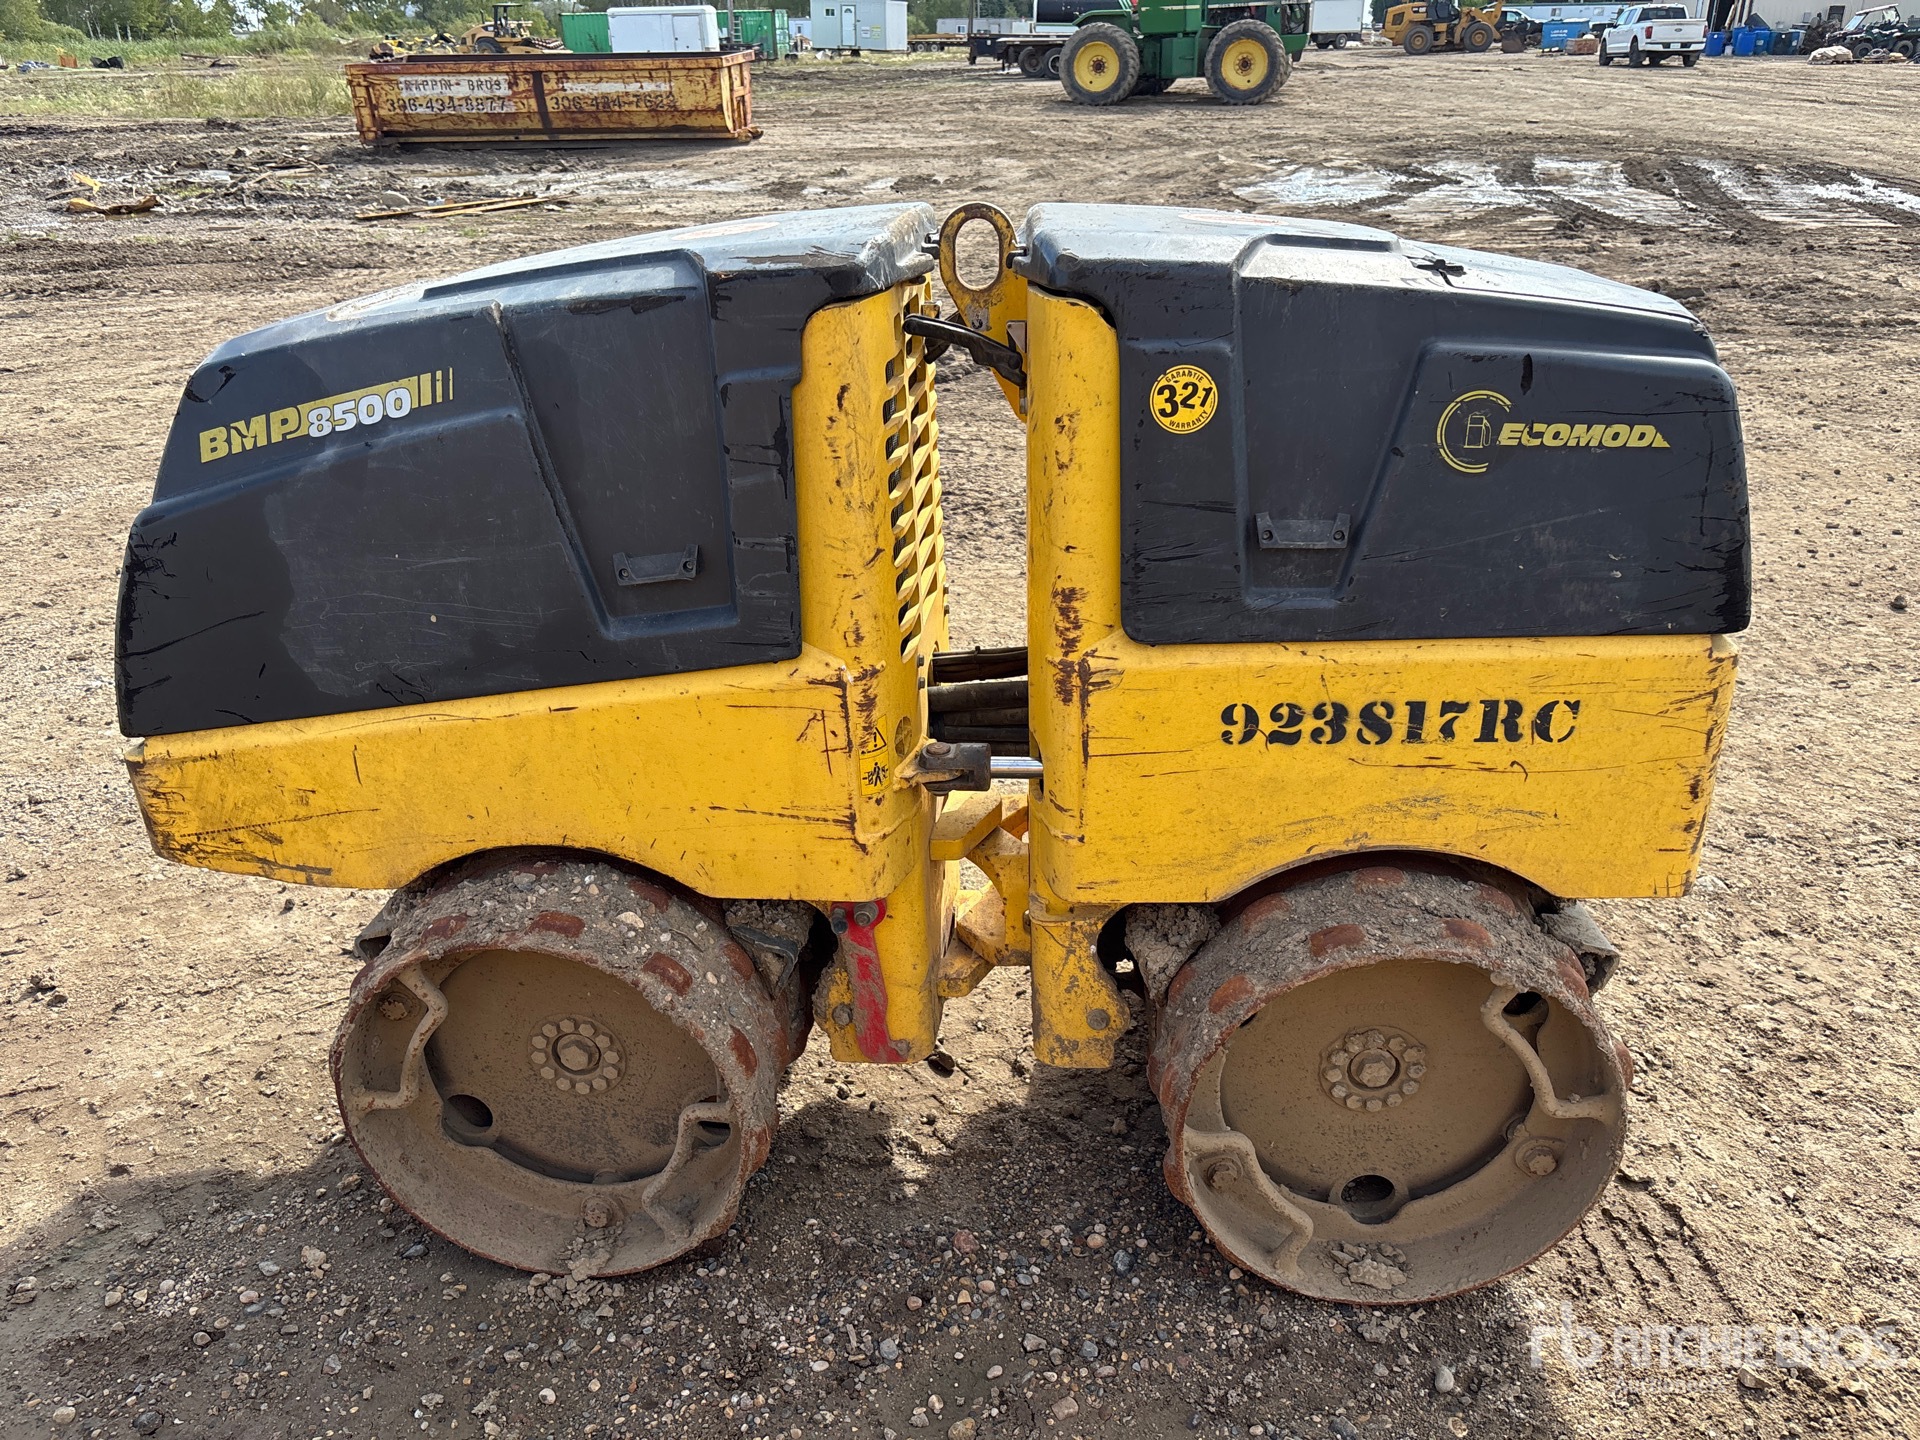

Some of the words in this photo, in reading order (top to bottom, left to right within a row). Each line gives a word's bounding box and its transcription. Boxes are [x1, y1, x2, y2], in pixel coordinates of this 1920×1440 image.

[1165, 370, 1204, 384] GARANTIE
[199, 405, 301, 463] BMP
[307, 388, 412, 438] 8500
[1169, 409, 1208, 430] WARRANTY
[1220, 700, 1581, 745] 923817RC
